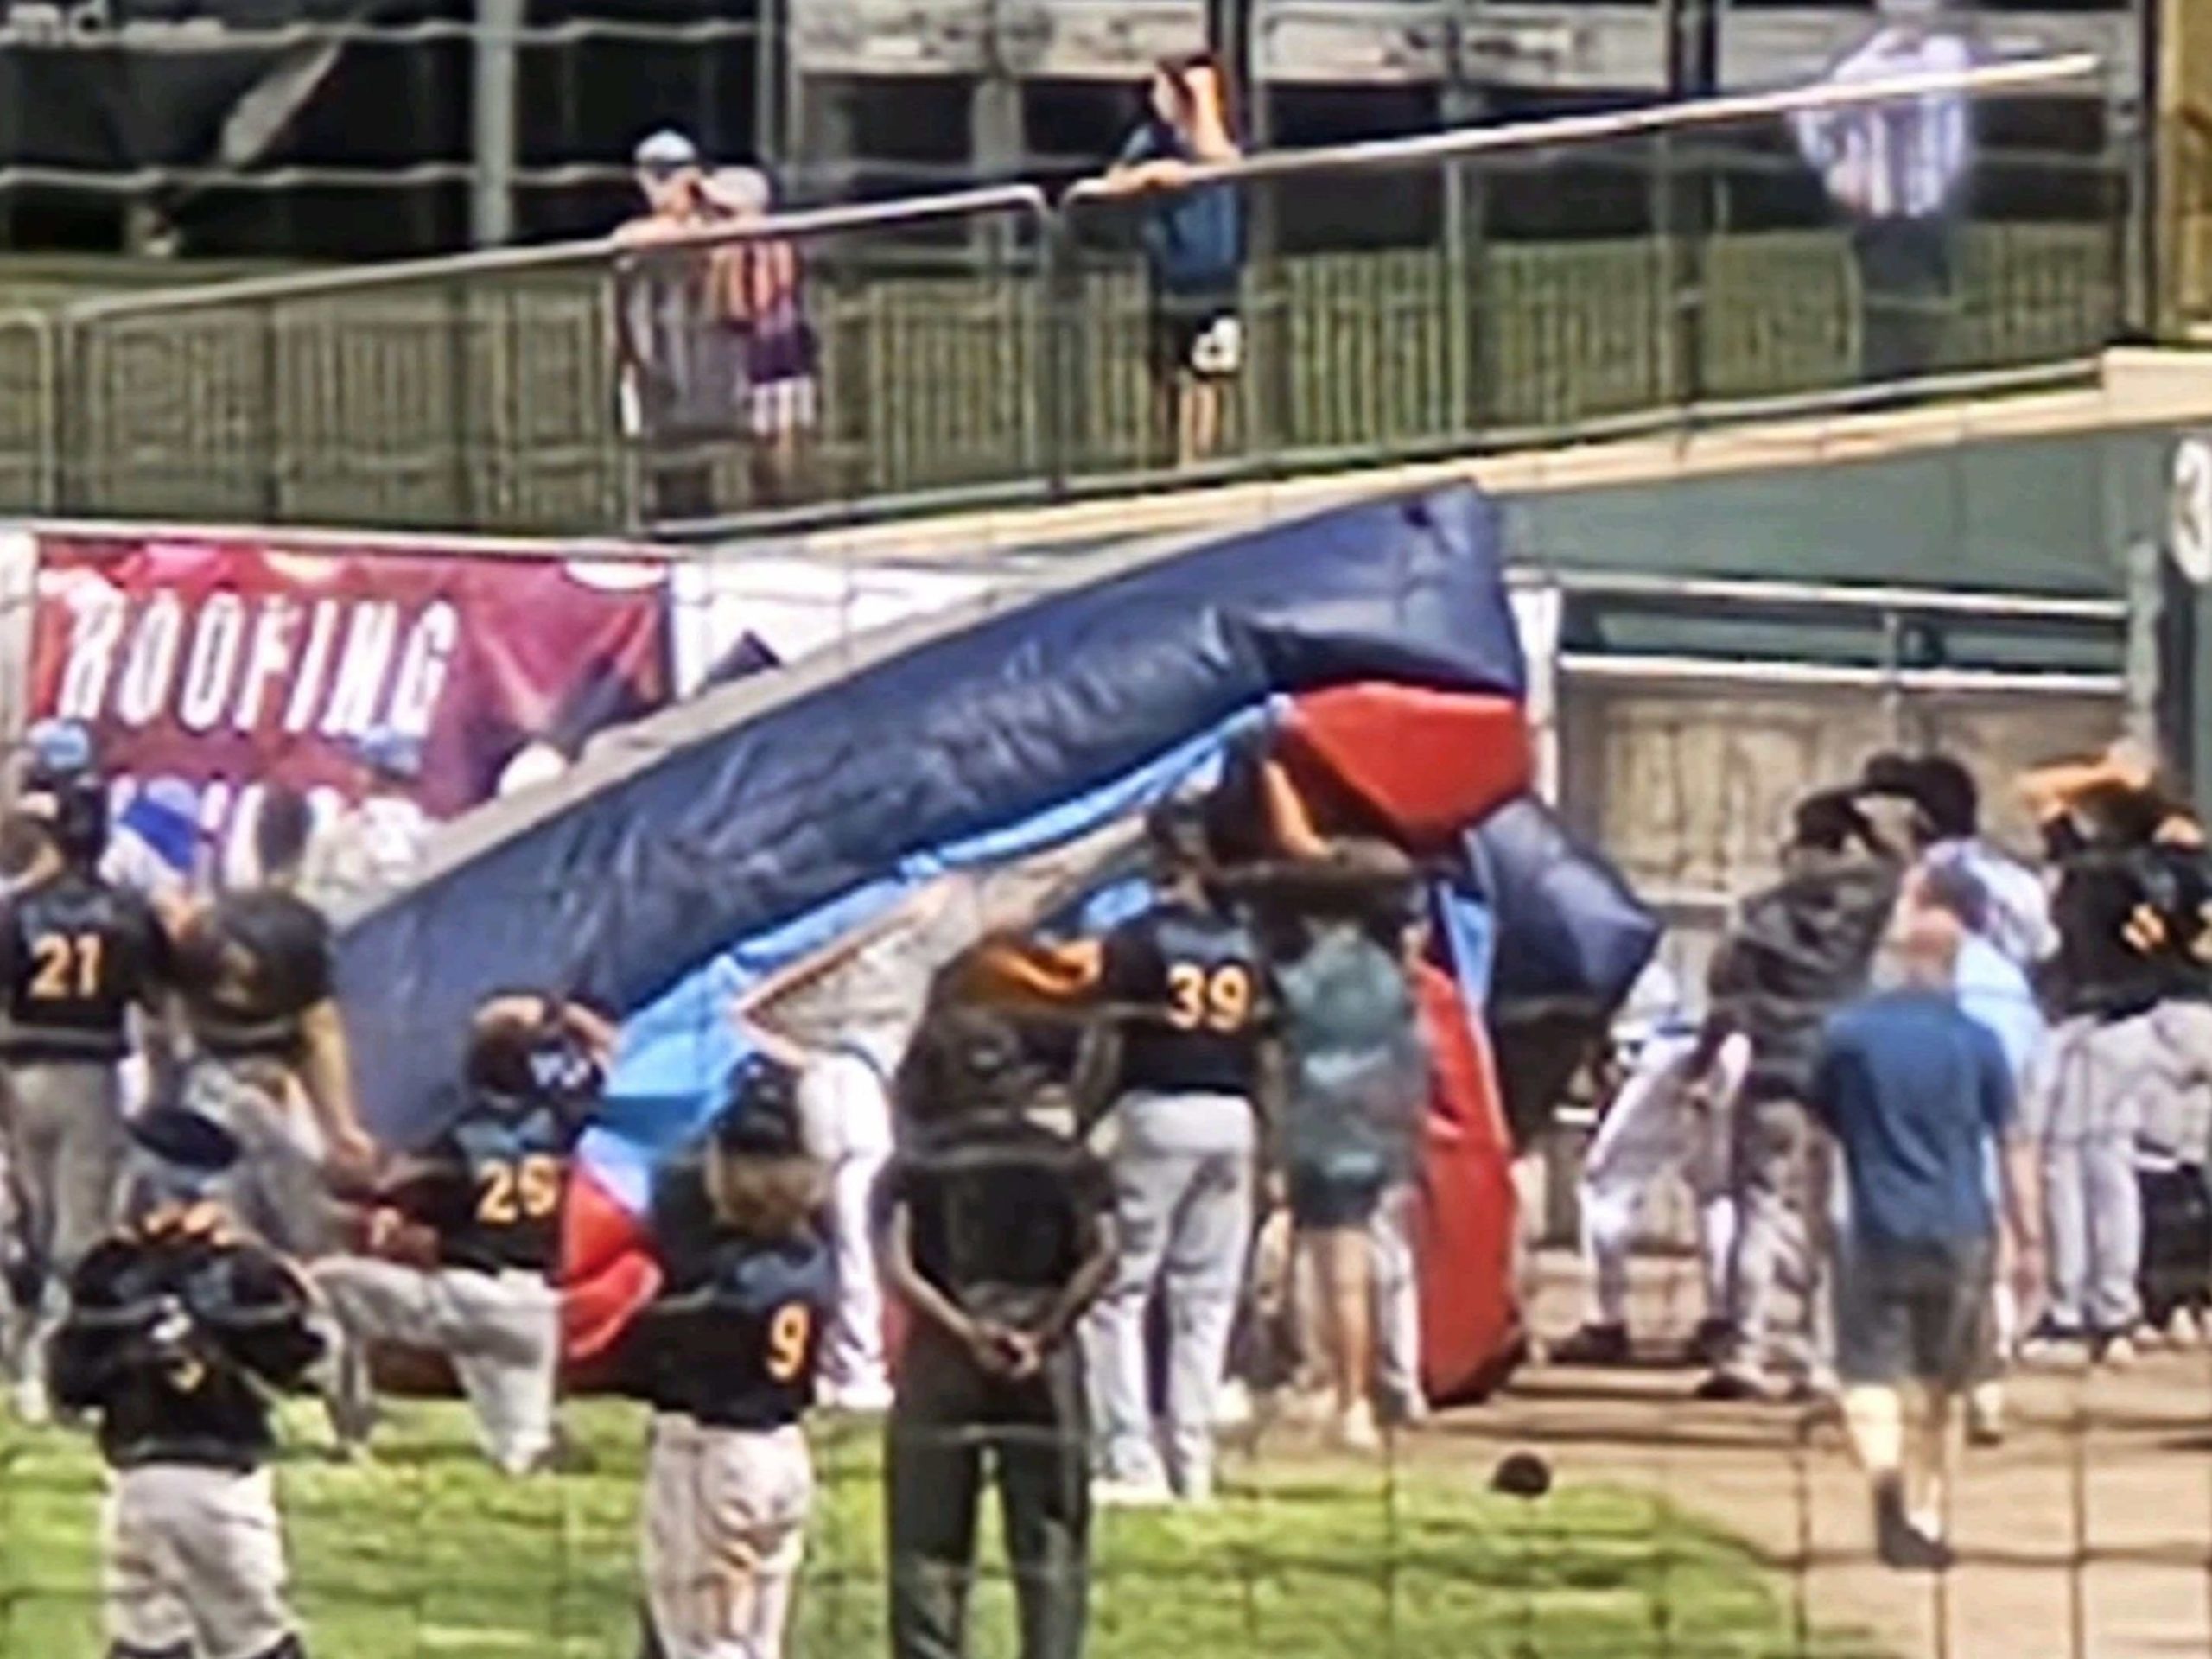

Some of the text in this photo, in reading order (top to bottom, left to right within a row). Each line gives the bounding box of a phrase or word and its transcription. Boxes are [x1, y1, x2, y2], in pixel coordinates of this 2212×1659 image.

[55, 588, 458, 737] ROOFING
[29, 931, 101, 998] 21
[1166, 961, 1249, 1030] 39
[767, 1301, 810, 1379] 9
